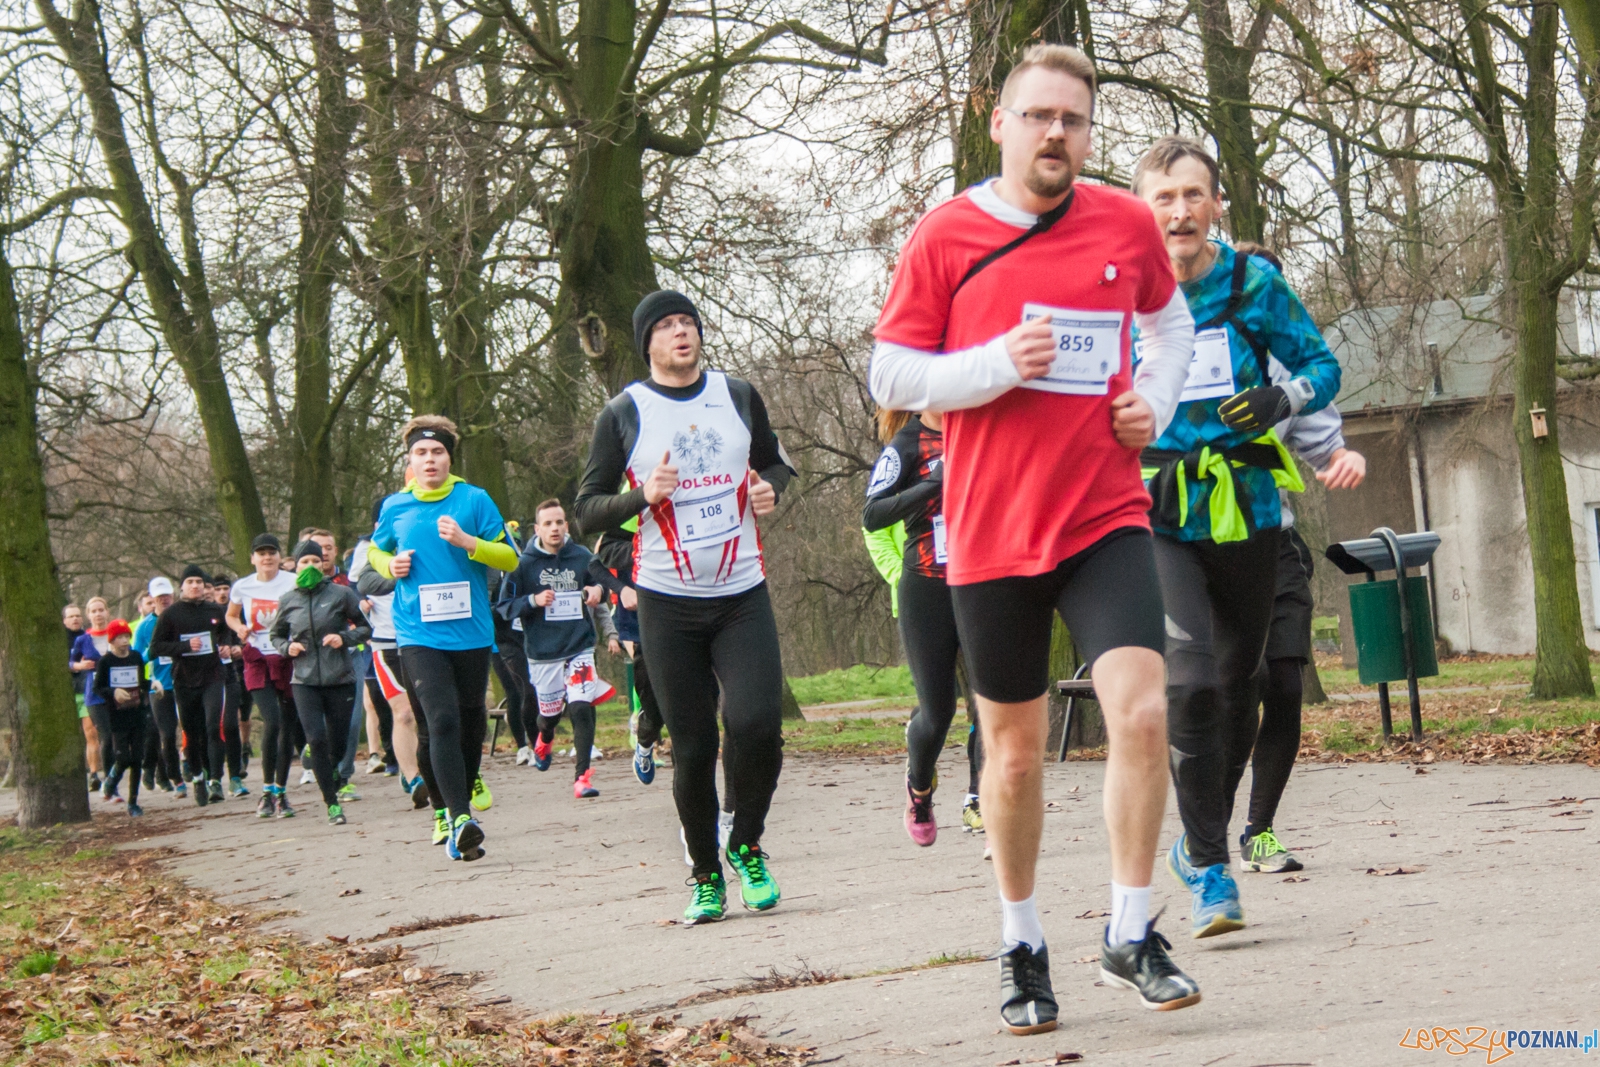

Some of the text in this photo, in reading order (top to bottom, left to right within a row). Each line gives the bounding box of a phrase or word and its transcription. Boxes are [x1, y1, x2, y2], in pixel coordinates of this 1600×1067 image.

[1059, 334, 1094, 352] 859
[699, 503, 723, 519] 108
[436, 592, 454, 601] 784
